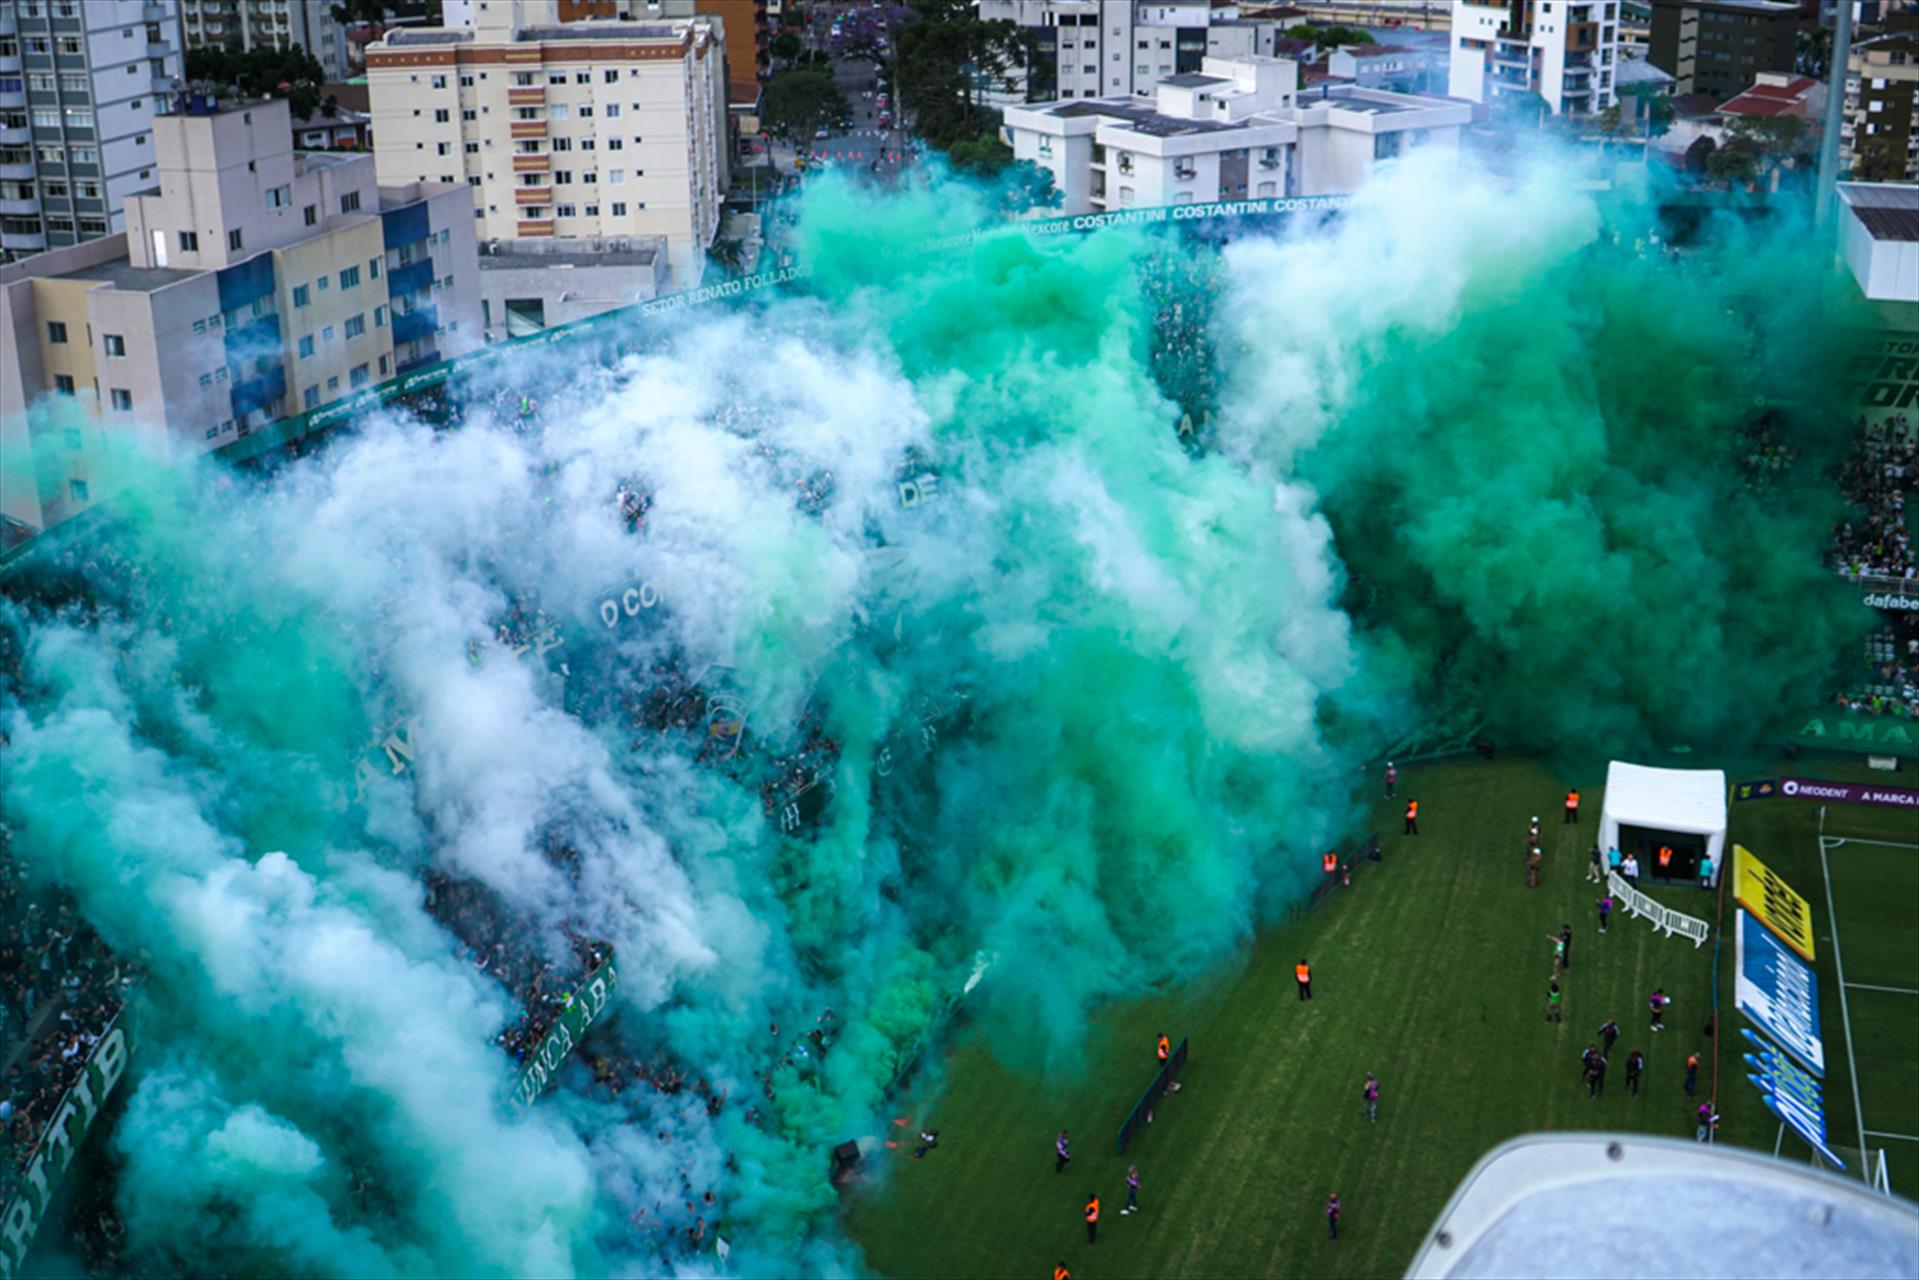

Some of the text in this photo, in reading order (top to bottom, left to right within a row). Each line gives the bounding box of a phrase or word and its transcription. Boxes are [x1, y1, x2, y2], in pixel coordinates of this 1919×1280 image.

[1073, 209, 1166, 230] COSTANTINI
[1172, 200, 1267, 220] COSTANTINI
[642, 295, 686, 318] SETOR
[688, 279, 741, 305] RENATO
[1799, 784, 1849, 798] NEODENT
[1873, 792, 1914, 805] MARCA
